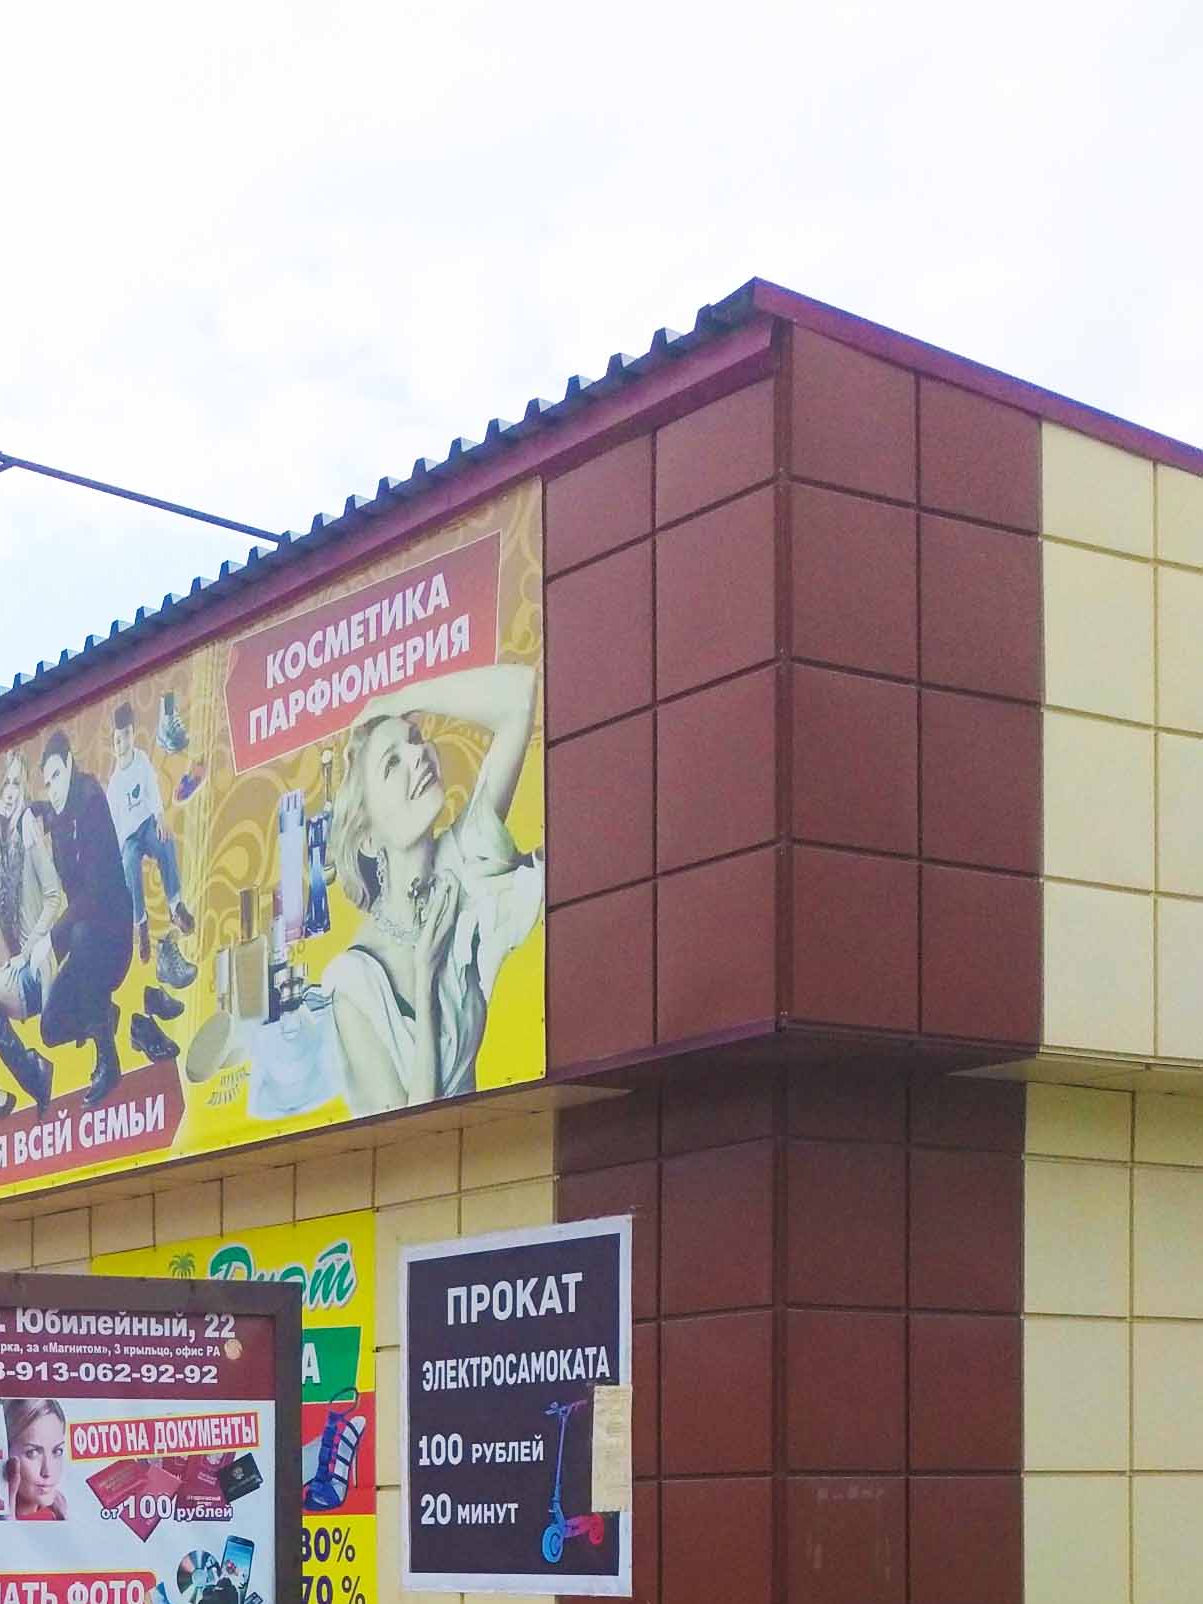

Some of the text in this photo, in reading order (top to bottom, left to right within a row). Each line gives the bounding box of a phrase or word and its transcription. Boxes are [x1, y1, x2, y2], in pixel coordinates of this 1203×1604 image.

[266, 573, 450, 689] КОСМЕТИКА
[249, 614, 470, 745] ПАРФЮМЕРИЯ
[13, 1109, 72, 1168] ВСЕЙ
[79, 1094, 166, 1147] СЕМЬИ
[447, 1271, 584, 1326] ПРОКАТ
[15, 1307, 196, 1341] Юбилейный,
[204, 1313, 236, 1338] 22
[26, 1344, 39, 1354] за
[42, 1341, 111, 1356] «Магнитом»,
[114, 1343, 122, 1356] 3
[123, 1345, 173, 1359] крыльцо,
[175, 1346, 204, 1359] офис
[206, 1347, 220, 1358] РА
[422, 1346, 611, 1391] ЭЛЕКТРОСАМОКАТА
[73, 1415, 258, 1455] ФОТО НА ДОКУМЕНТЫ
[418, 1432, 544, 1466] 100 РУБЛЕЙ
[101, 1508, 119, 1520] от
[123, 1494, 173, 1520] 100
[176, 1504, 234, 1522] рублей
[420, 1493, 519, 1526] 20 МИНУТ
